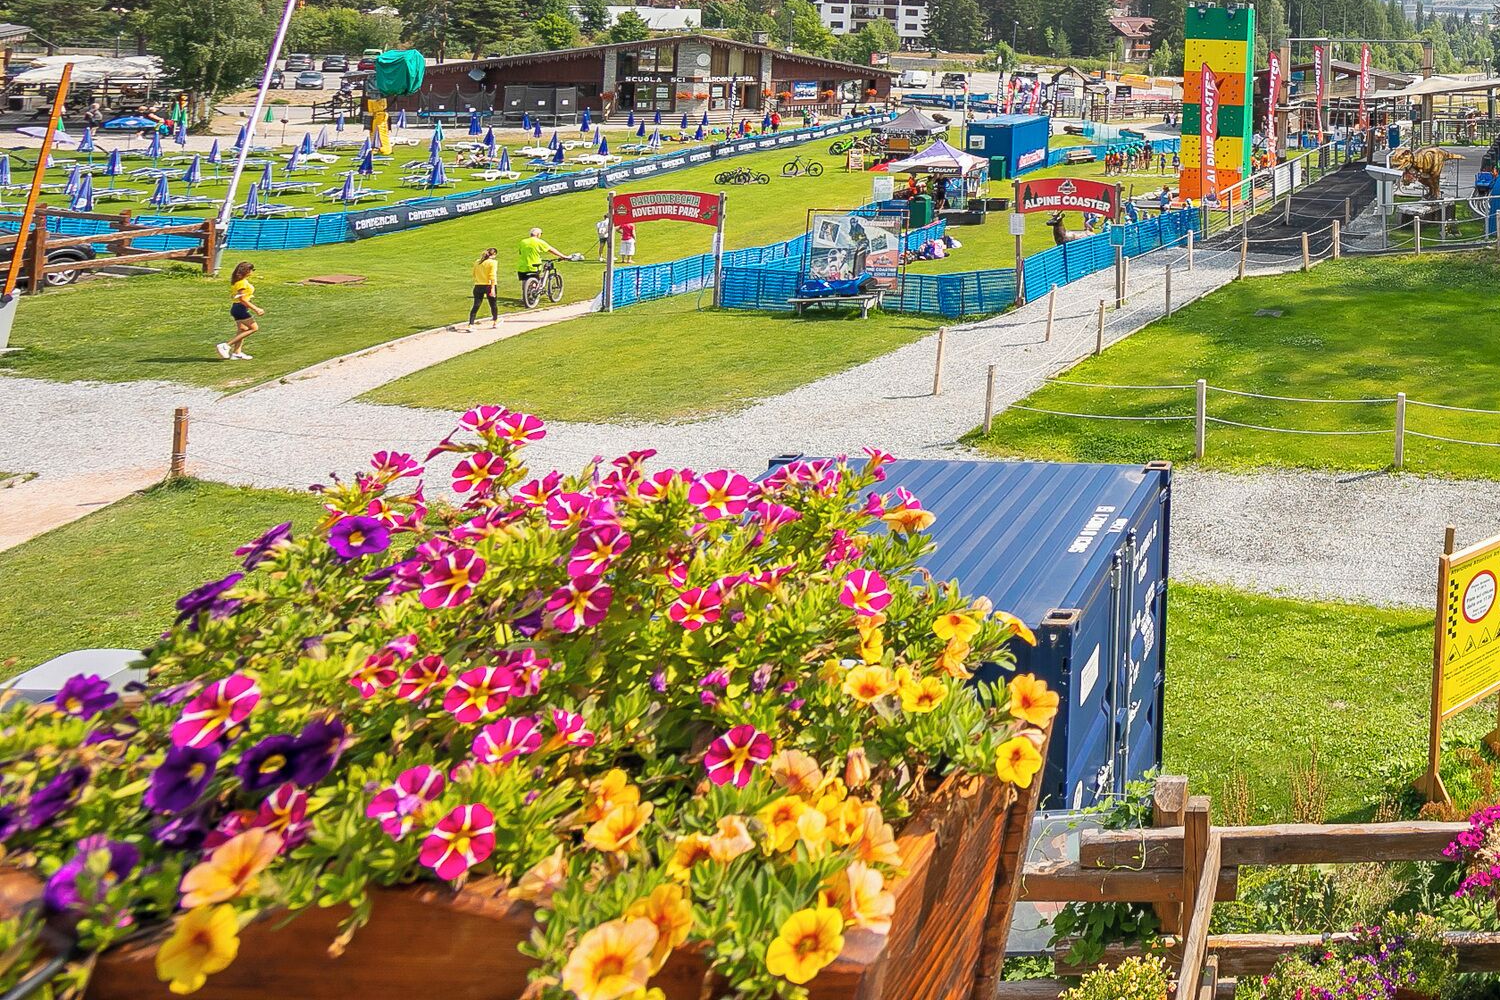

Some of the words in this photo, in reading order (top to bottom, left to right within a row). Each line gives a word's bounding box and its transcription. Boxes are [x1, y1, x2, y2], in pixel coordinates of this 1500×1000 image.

[630, 193, 701, 208] BARDONECCHIA
[1024, 195, 1061, 210] ALPINE
[1062, 195, 1111, 212] COASTER
[632, 205, 677, 218] ADVENTURE
[678, 206, 700, 219] PARK
[355, 214, 399, 230] COMMENCAL
